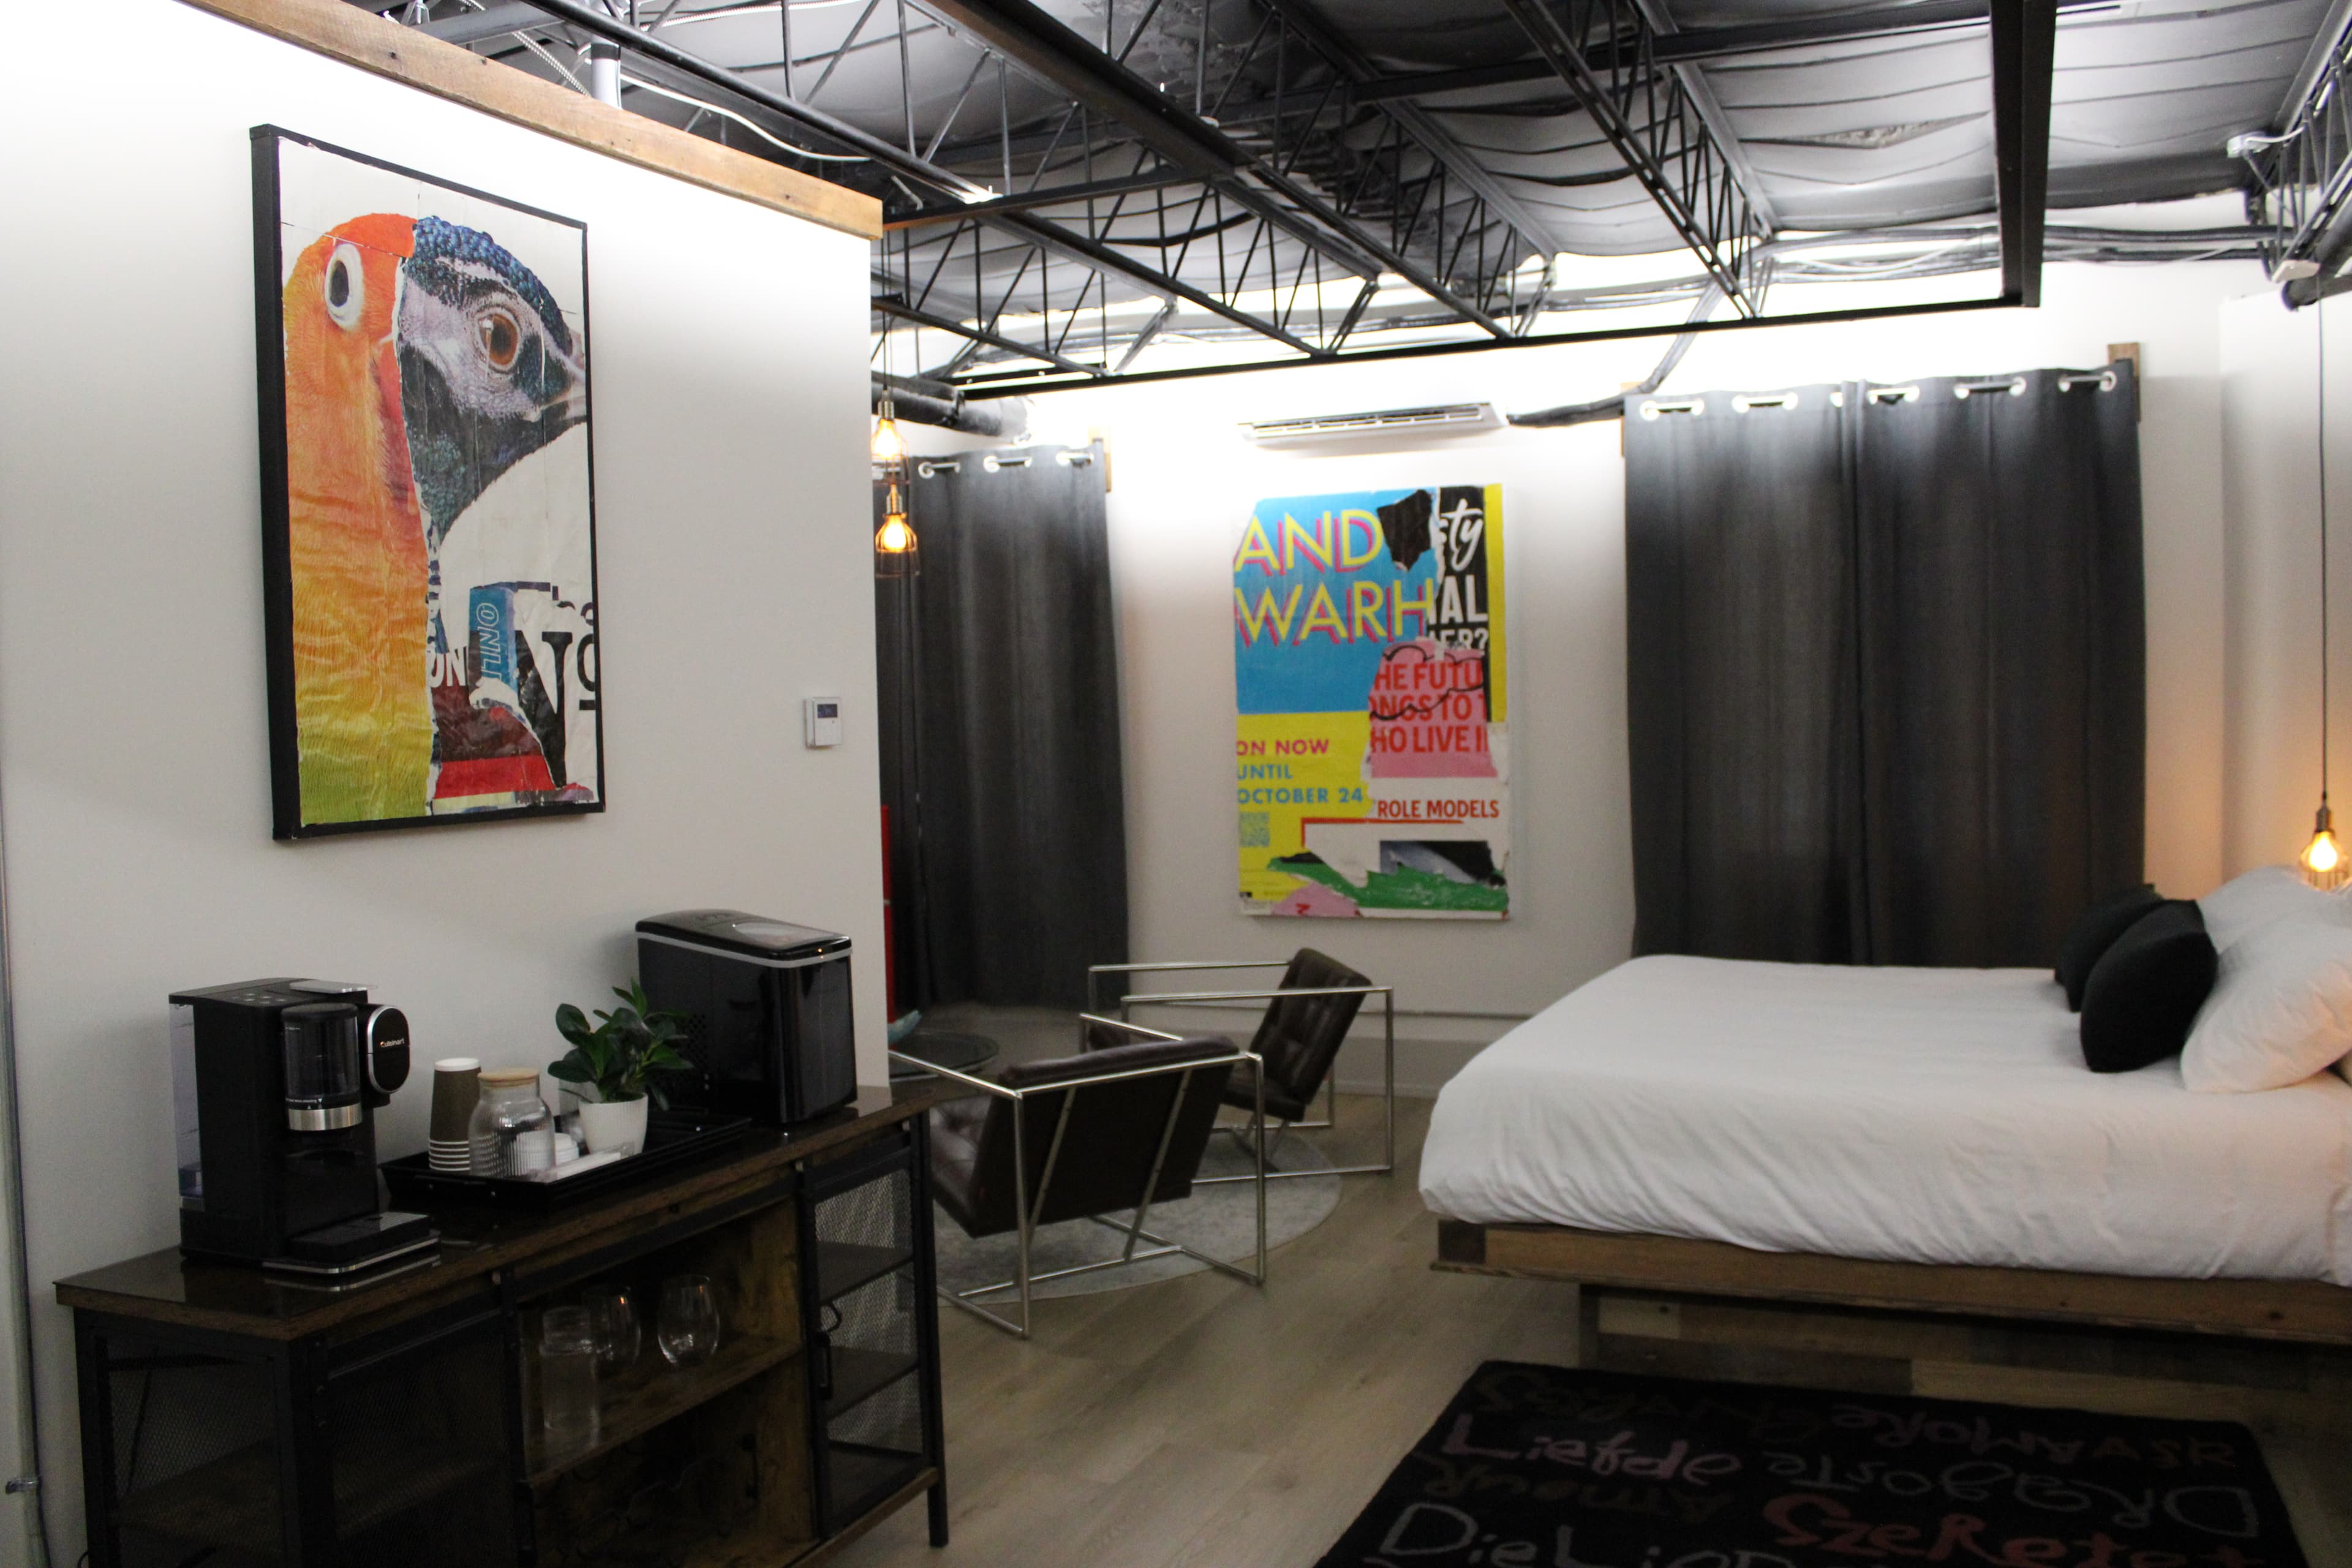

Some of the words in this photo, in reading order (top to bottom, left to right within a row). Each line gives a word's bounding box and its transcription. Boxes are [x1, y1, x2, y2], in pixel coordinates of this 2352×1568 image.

[1236, 739, 1266, 756] ON
[1275, 738, 1330, 755] NOW
[1412, 725, 1470, 753] LIVE
[1237, 764, 1294, 780] UNTIL
[1237, 787, 1329, 804] OCTOBER
[1338, 786, 1363, 804] 24
[1378, 799, 1422, 819] ROLE
[1426, 799, 1500, 819] MODELS
